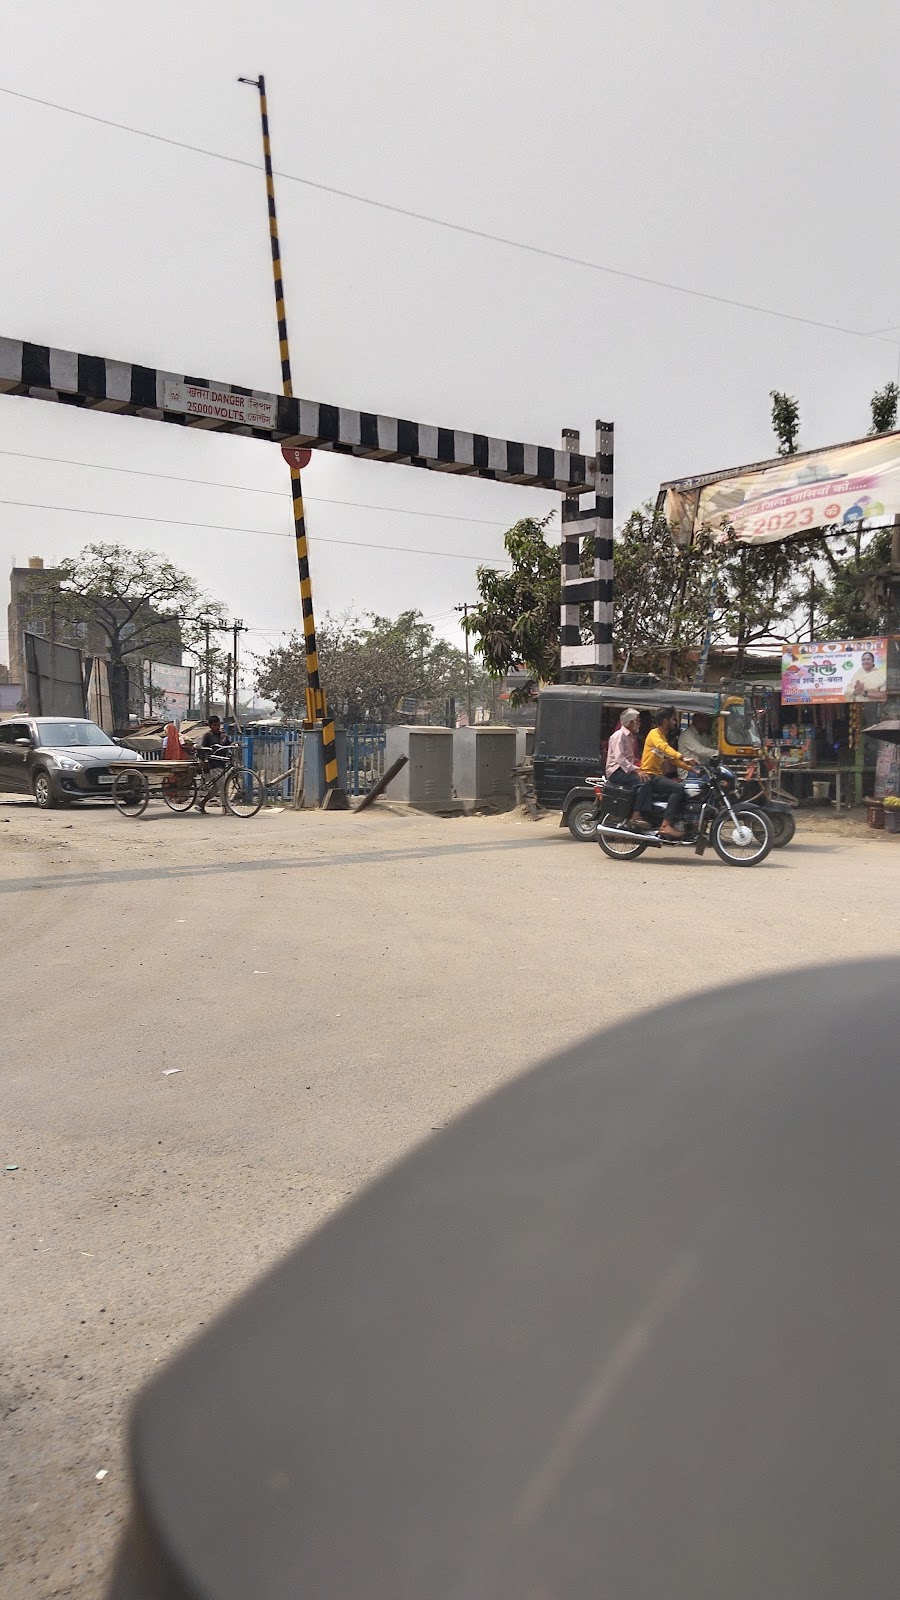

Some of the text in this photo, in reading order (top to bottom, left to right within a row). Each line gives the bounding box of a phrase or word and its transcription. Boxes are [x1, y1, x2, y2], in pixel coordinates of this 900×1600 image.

[187, 386, 209, 401] खतरा
[211, 391, 245, 408] DANGER
[753, 507, 815, 537] 2023
[804, 659, 837, 676] होली
